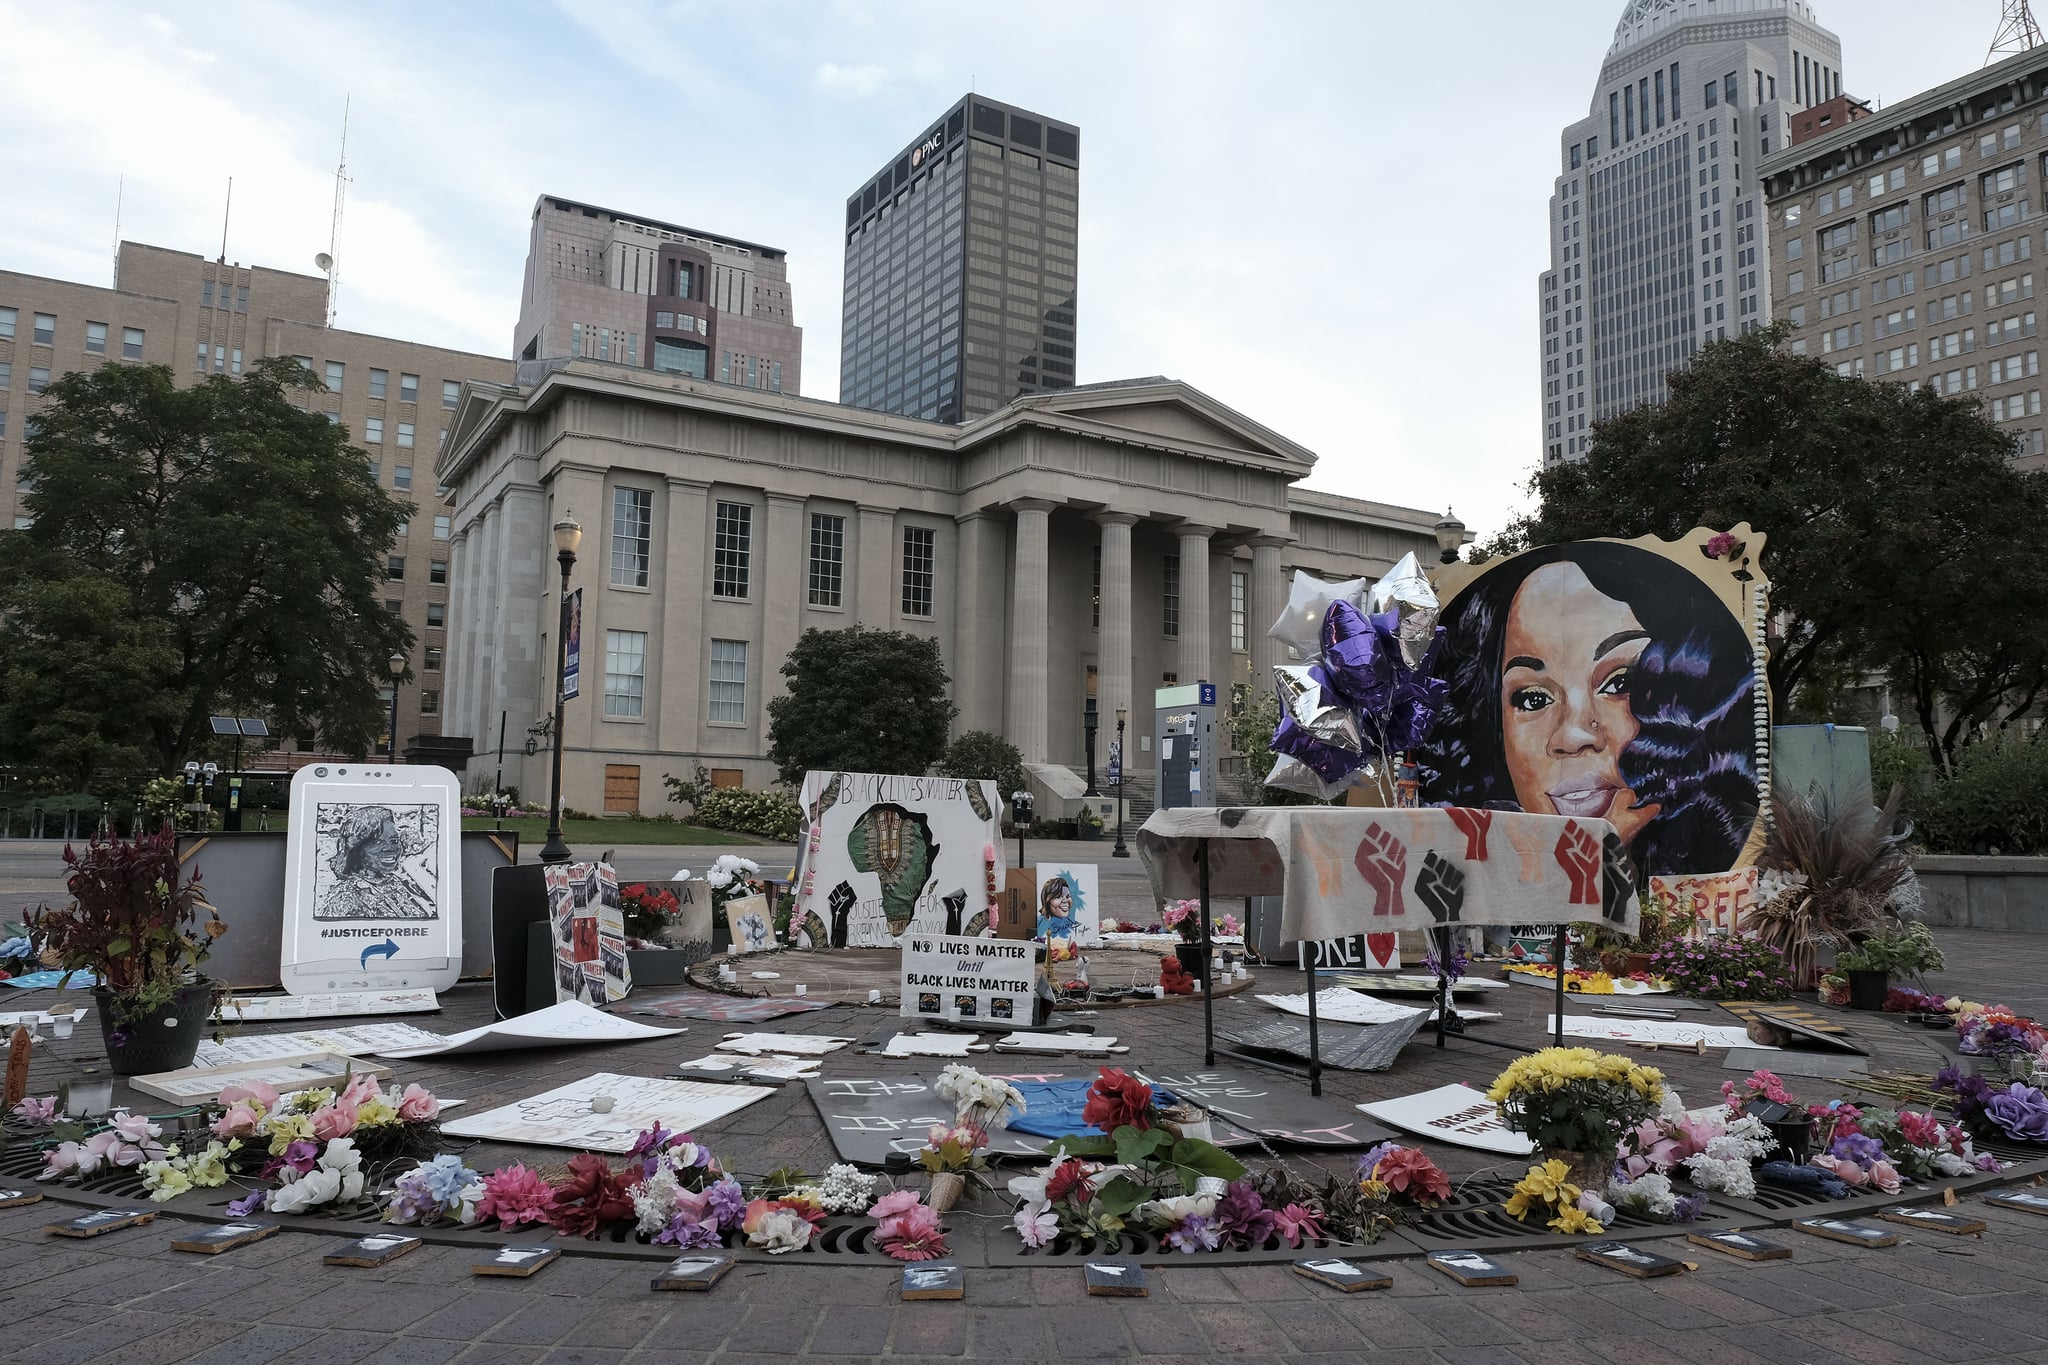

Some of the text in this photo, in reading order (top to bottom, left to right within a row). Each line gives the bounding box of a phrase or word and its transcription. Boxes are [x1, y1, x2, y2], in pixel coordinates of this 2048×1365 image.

[922, 132, 941, 158] PNC
[321, 927, 429, 939] #JUSTICEFORBRE
[940, 942, 970, 956] LIVES
[976, 945, 1026, 959] MATTER
[956, 960, 984, 973] Until
[907, 973, 1029, 993] BLACK LIVES MATTER
[824, 1080, 927, 1096] It's
[832, 1115, 946, 1131] It's
[1426, 1103, 1497, 1129] BREONNA
